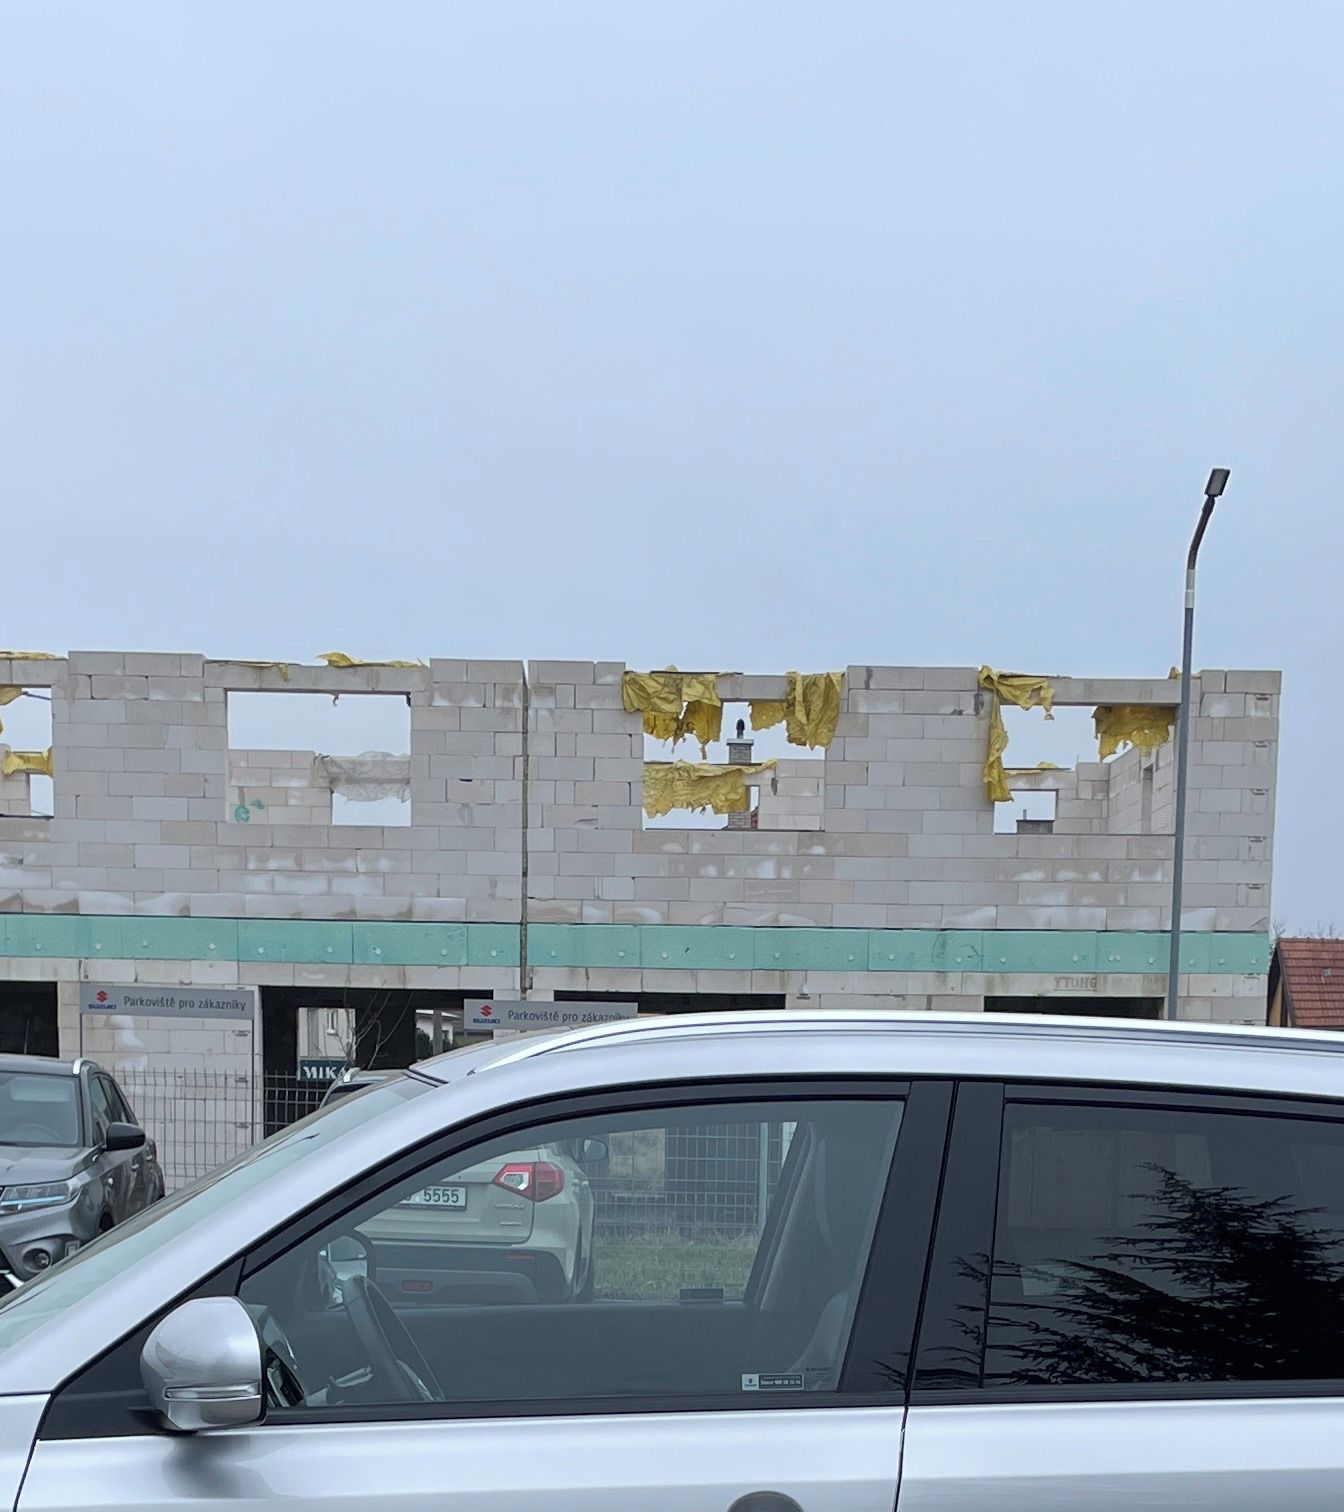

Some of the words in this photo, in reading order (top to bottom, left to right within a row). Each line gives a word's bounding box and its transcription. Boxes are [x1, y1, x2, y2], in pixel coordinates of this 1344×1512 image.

[124, 996, 176, 1008] Parkoviště
[178, 1001, 195, 1010] pro
[198, 998, 246, 1012] zákazníky
[508, 1009, 559, 1022] Parkoviště
[561, 1014, 579, 1024] pro
[423, 1188, 460, 1203] 5555
